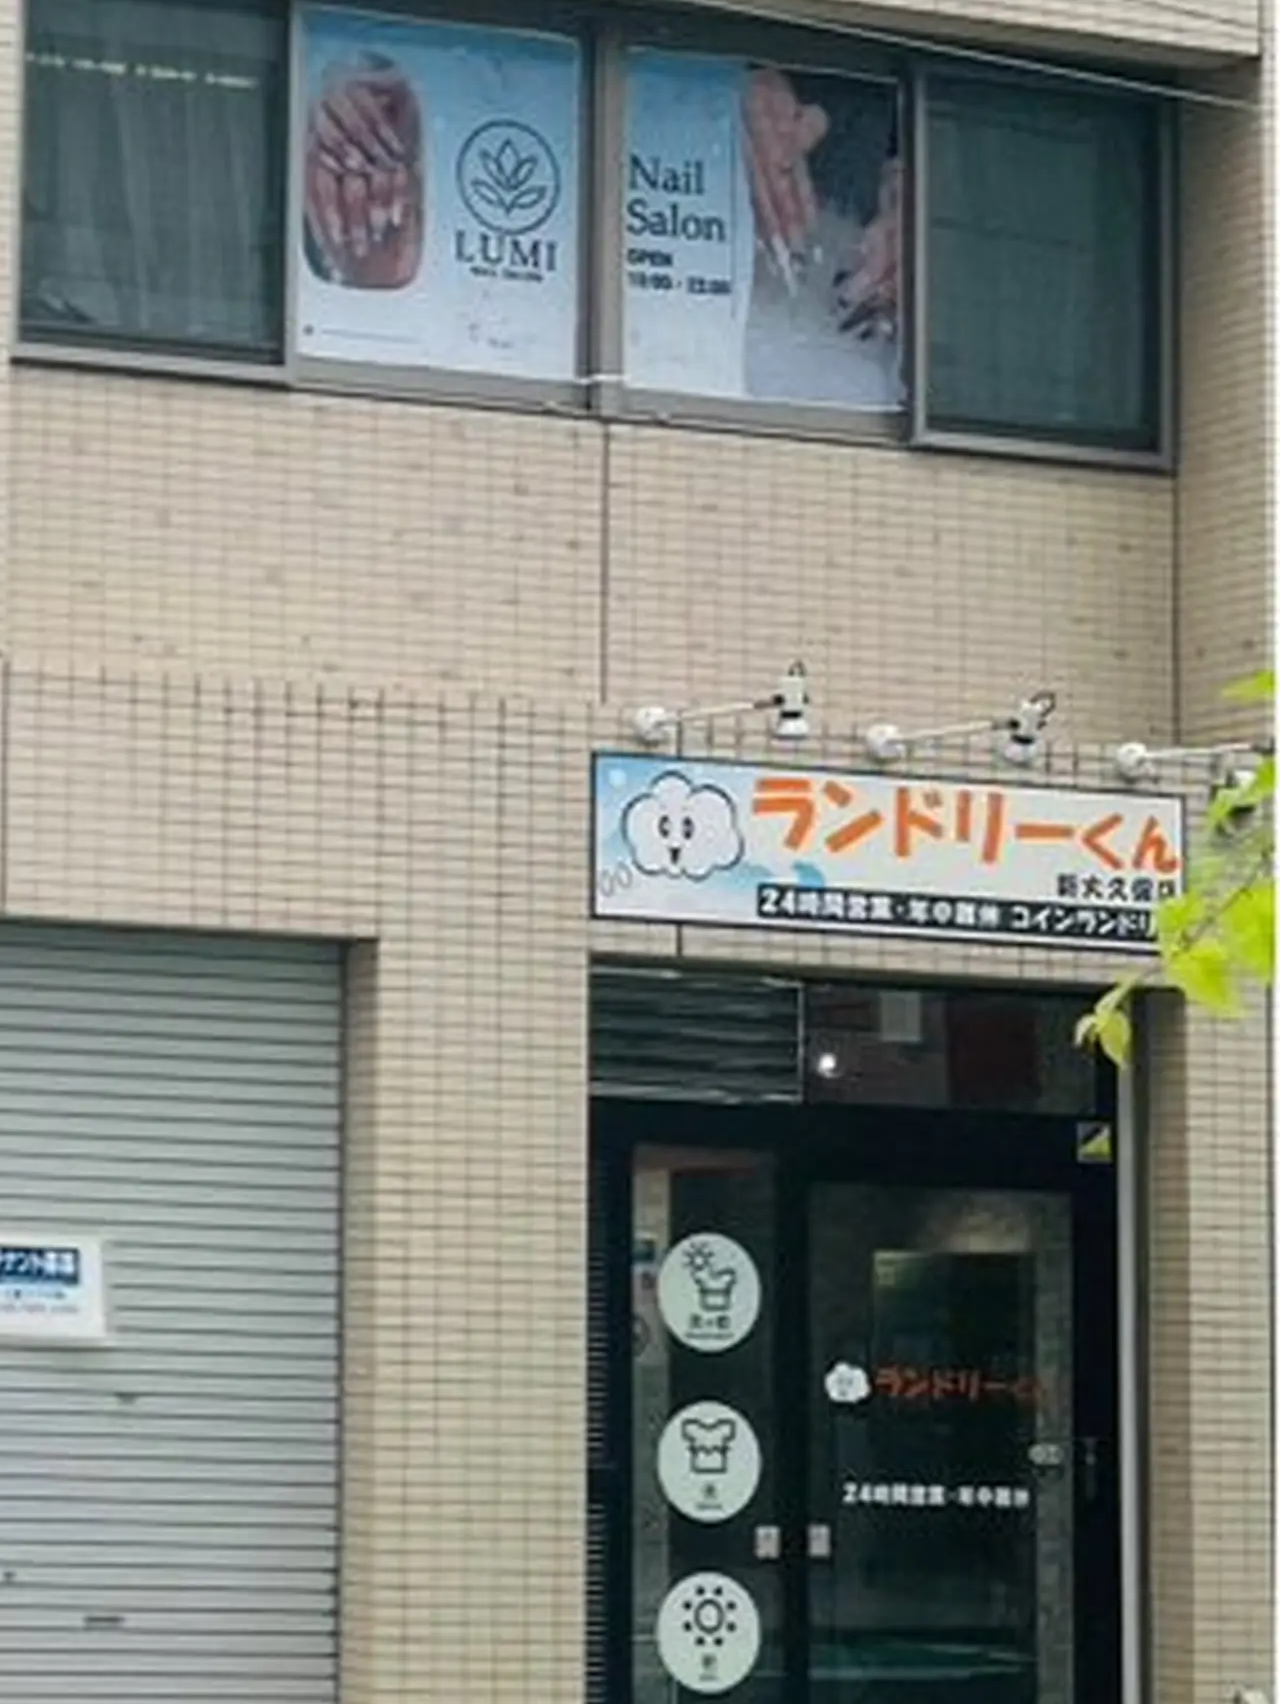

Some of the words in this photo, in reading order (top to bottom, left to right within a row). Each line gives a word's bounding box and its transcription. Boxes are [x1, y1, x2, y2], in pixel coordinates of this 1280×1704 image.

[629, 154, 705, 195] Nail
[626, 198, 727, 242] Salon
[454, 229, 558, 273] LUMI
[752, 778, 1179, 874] ランドリーくん
[1010, 905, 1156, 939] コインランドリ
